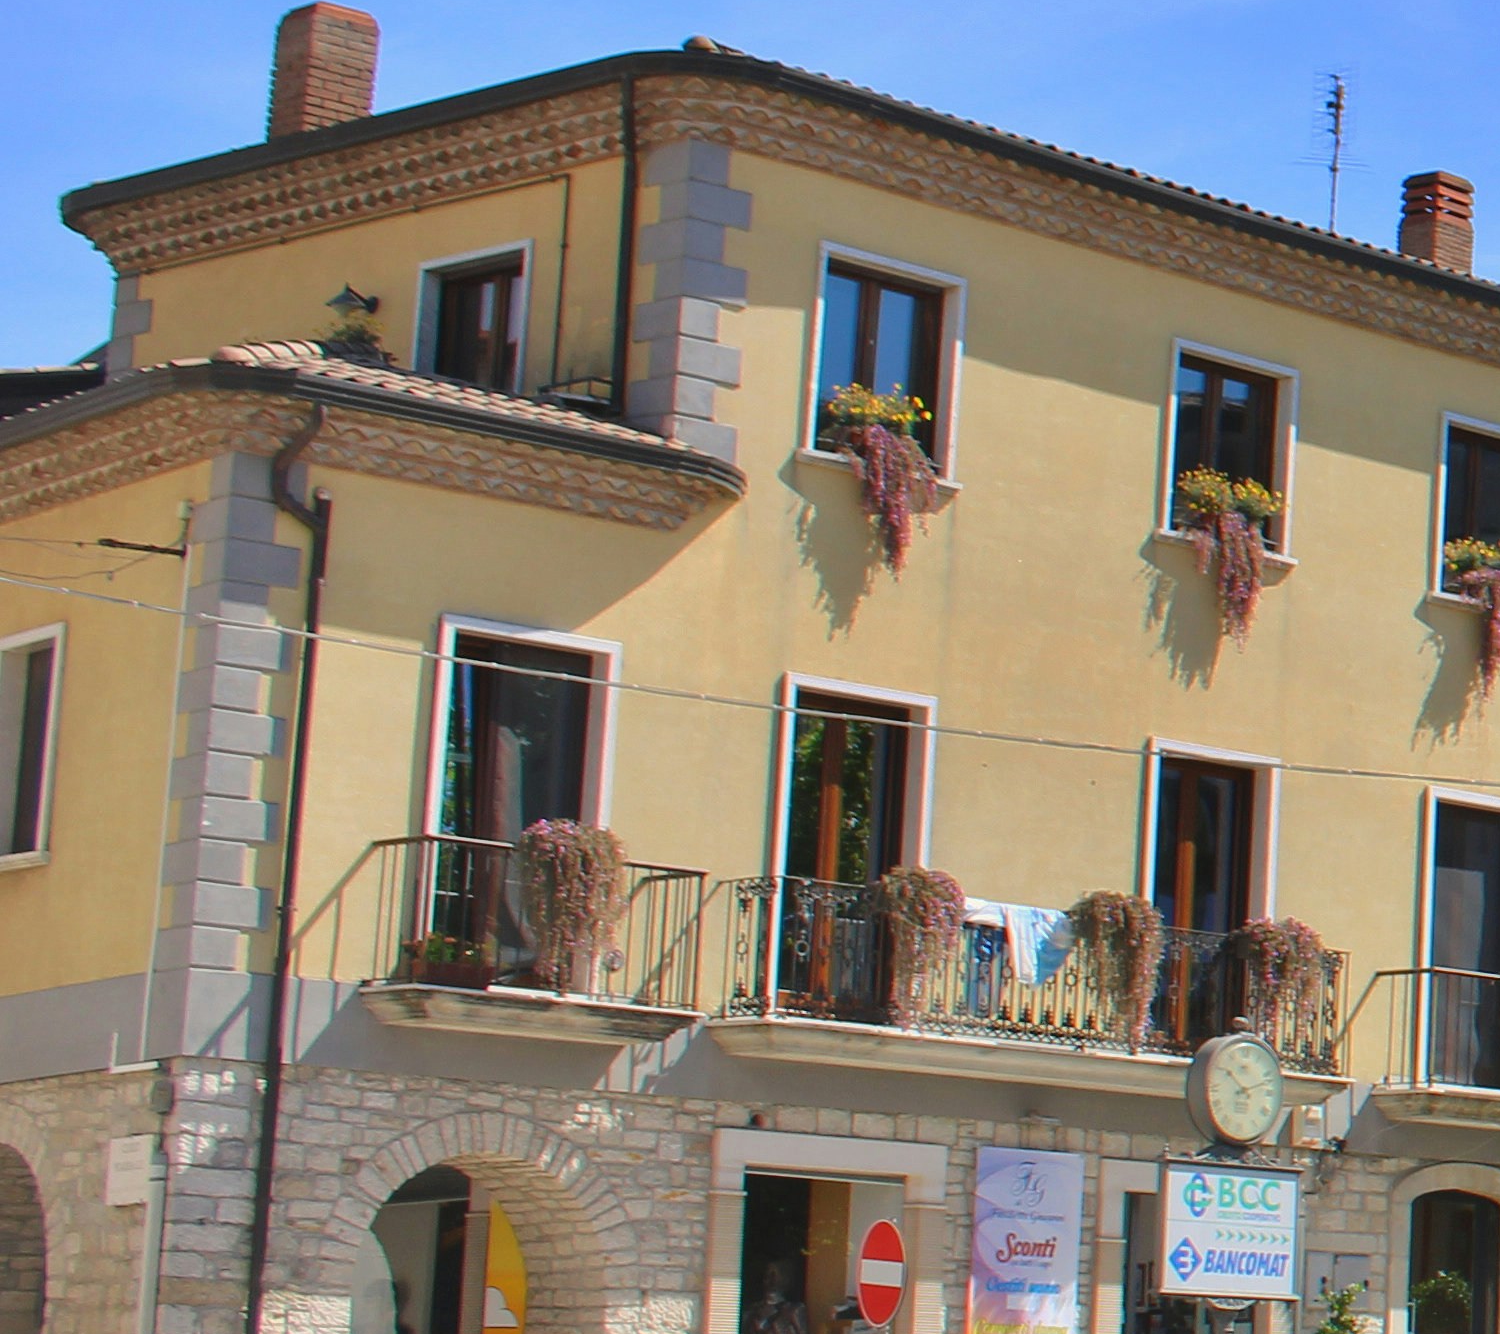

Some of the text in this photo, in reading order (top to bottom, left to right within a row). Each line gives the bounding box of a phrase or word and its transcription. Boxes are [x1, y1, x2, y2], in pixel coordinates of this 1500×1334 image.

[1217, 1177, 1281, 1212] BCC
[995, 1232, 1057, 1263] Sconti
[1203, 1248, 1291, 1278] BANCOMAT
